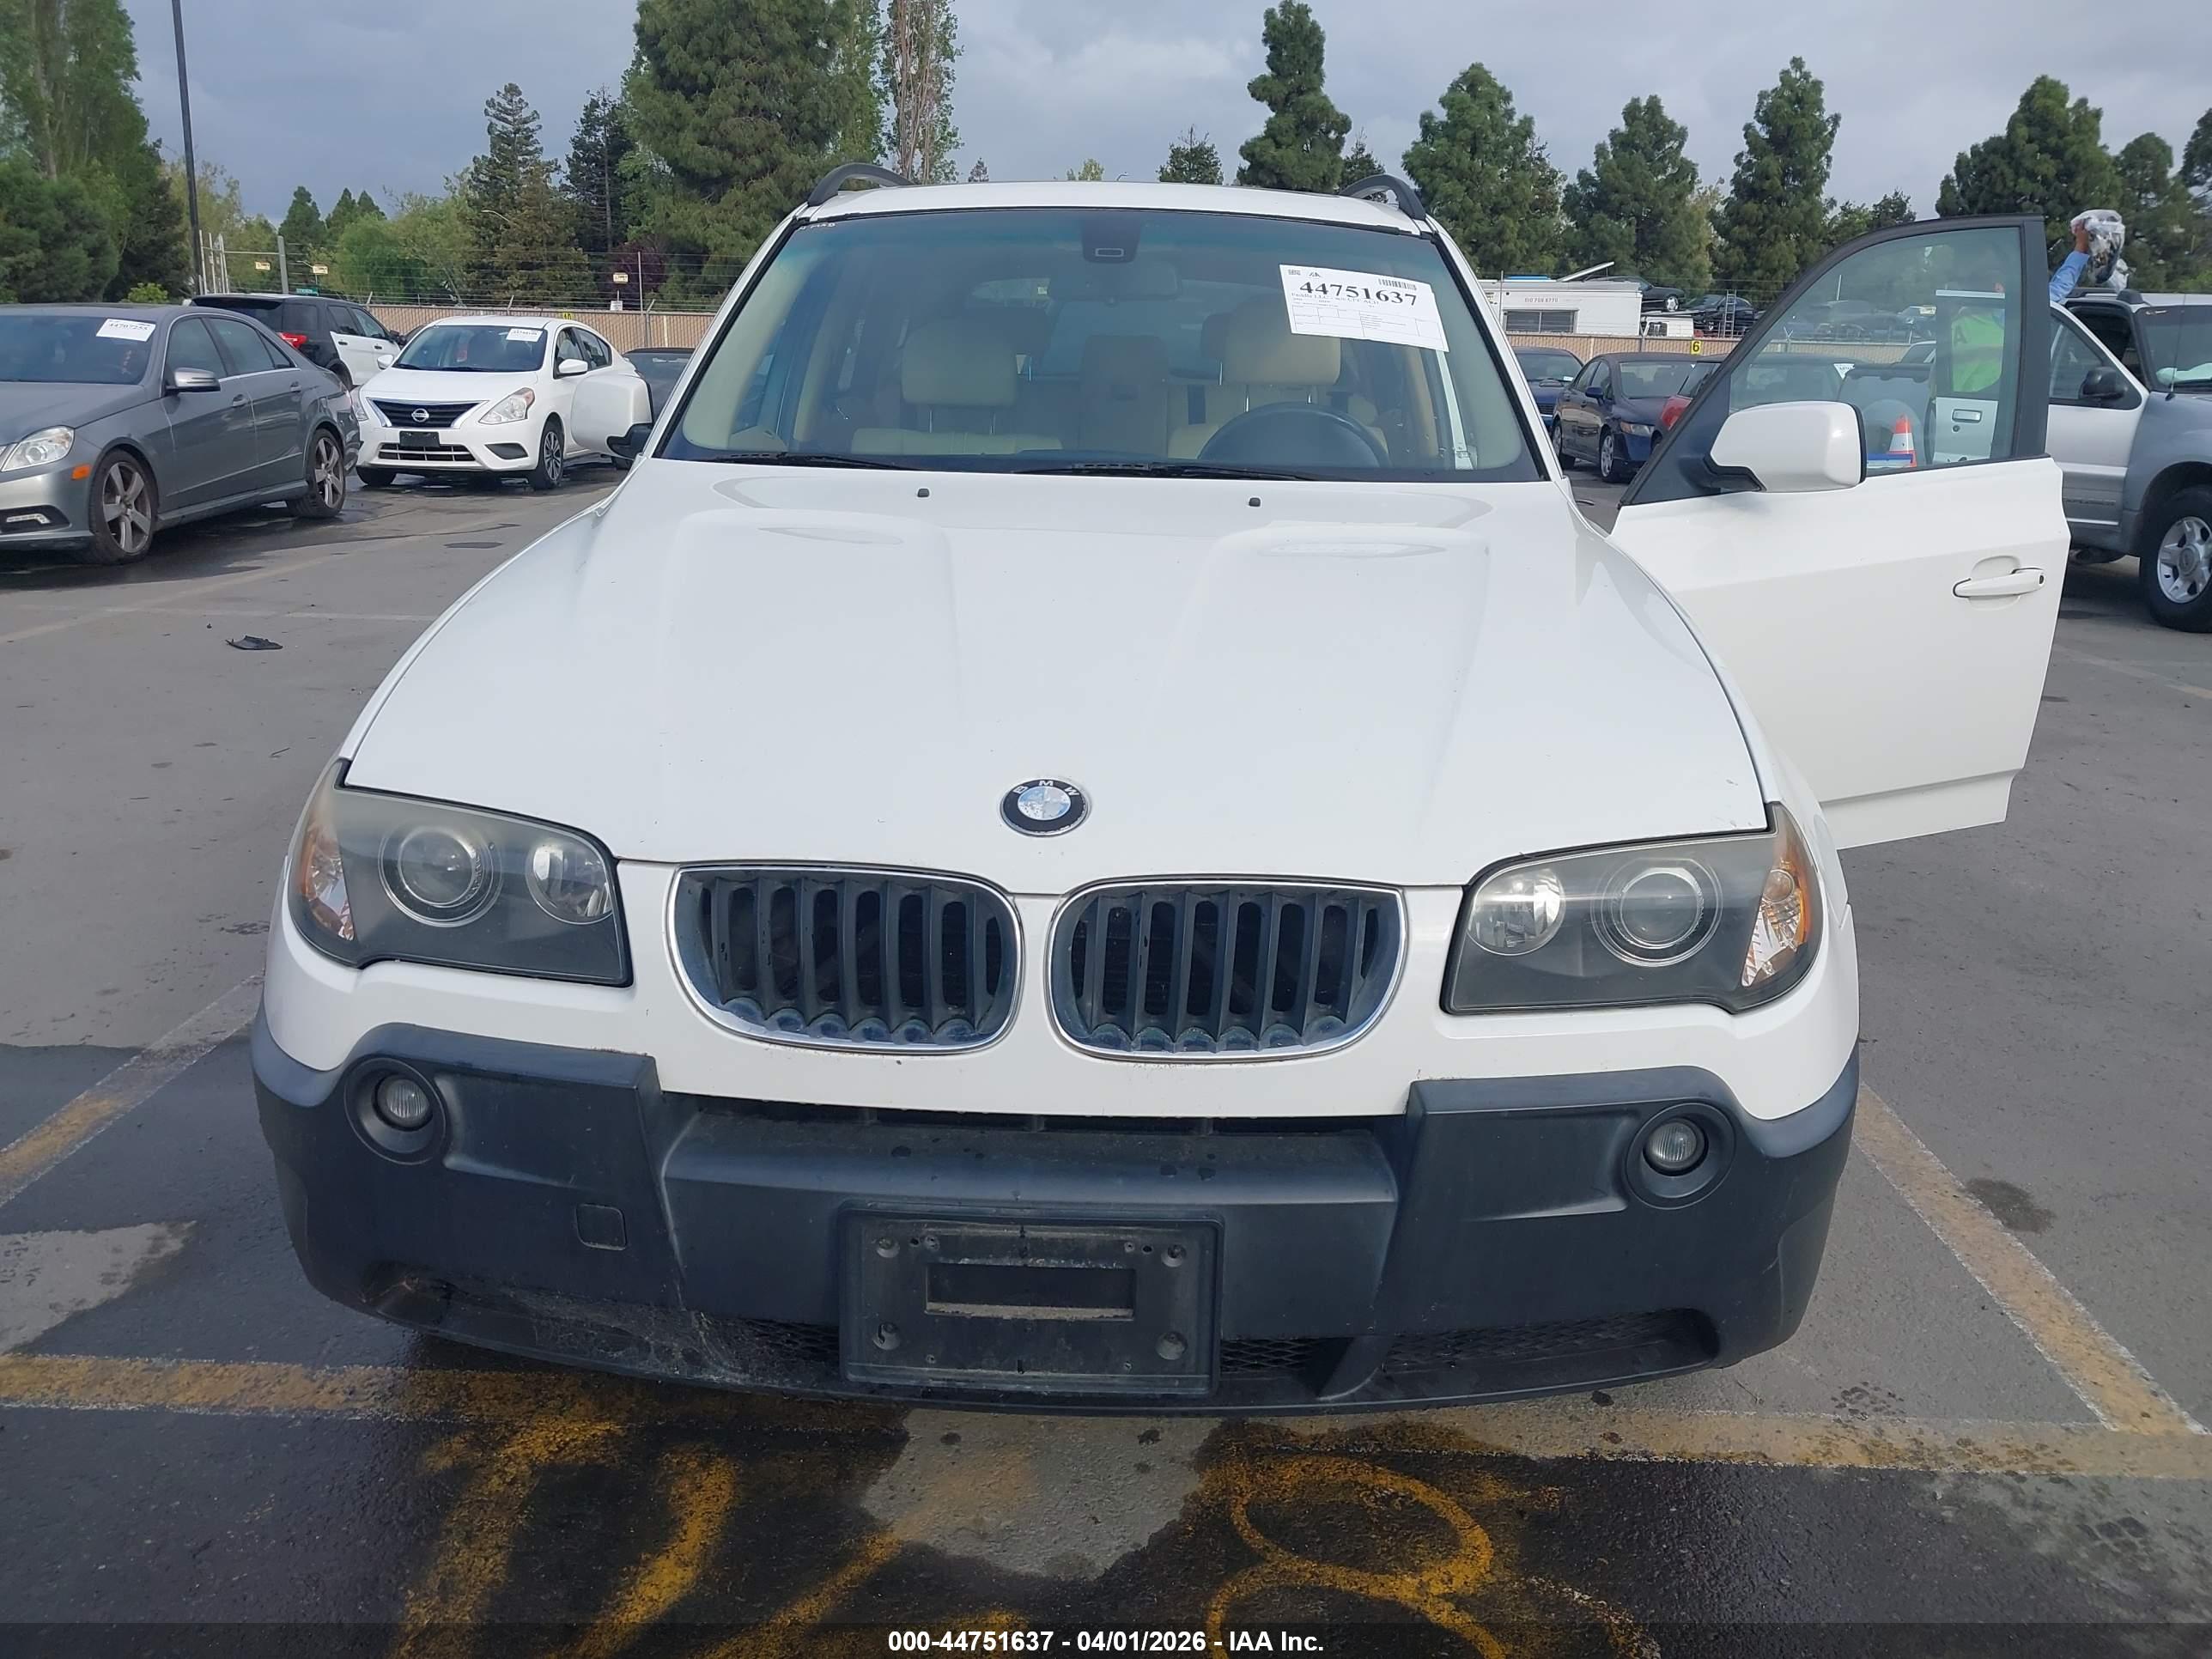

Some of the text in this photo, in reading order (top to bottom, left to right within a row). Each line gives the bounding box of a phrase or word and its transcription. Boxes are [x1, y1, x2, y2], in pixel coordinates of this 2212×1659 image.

[1299, 281, 1417, 307] 44751637
[1692, 341, 1700, 352] 6
[1012, 780, 1080, 797] BMW
